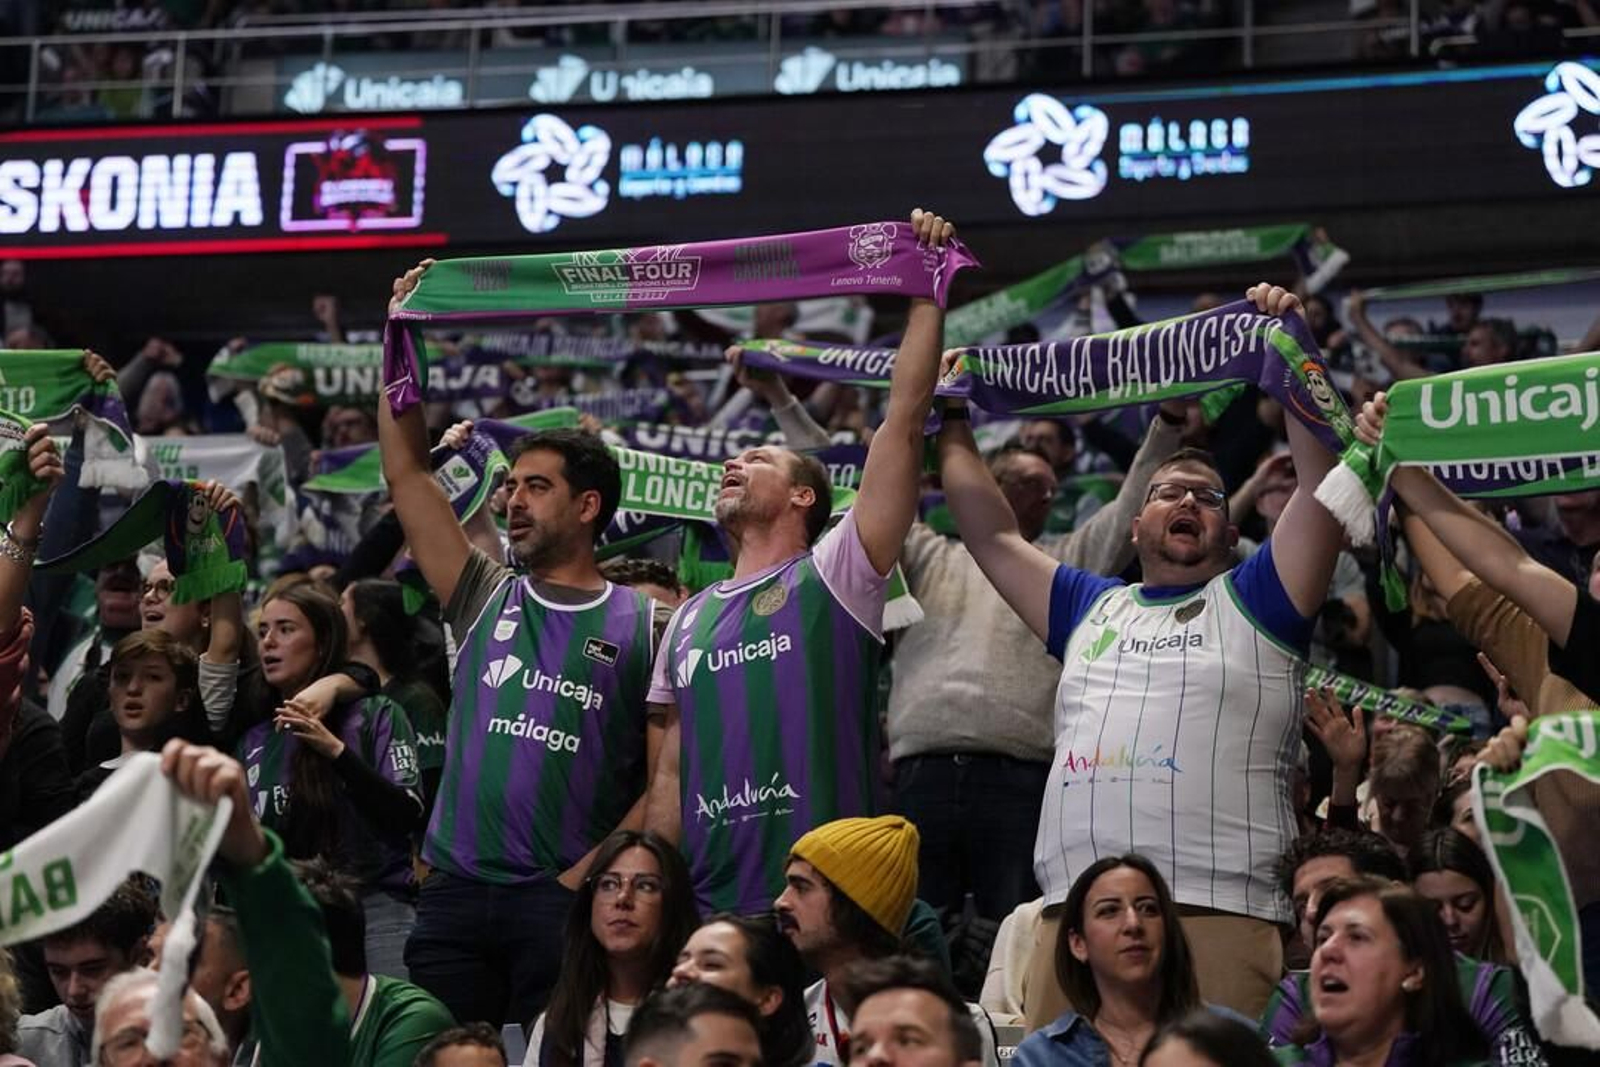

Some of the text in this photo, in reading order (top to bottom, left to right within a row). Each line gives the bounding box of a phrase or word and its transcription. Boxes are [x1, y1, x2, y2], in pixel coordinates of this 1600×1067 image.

[0, 152, 263, 233] SKONIA
[561, 262, 693, 284] FINAL FOUR
[831, 275, 903, 287] Lenovo Tenerife
[978, 336, 1097, 400] UNICAJA
[1107, 313, 1284, 400] BALONCESTO
[314, 365, 500, 396] UNAJA
[1420, 366, 1600, 432] Unicaj
[707, 632, 792, 672] Unicaja
[1118, 630, 1203, 653] Unicaja
[522, 668, 603, 711] Unicaja
[1064, 745, 1183, 774] Andalucía
[695, 771, 801, 824] Andalucía
